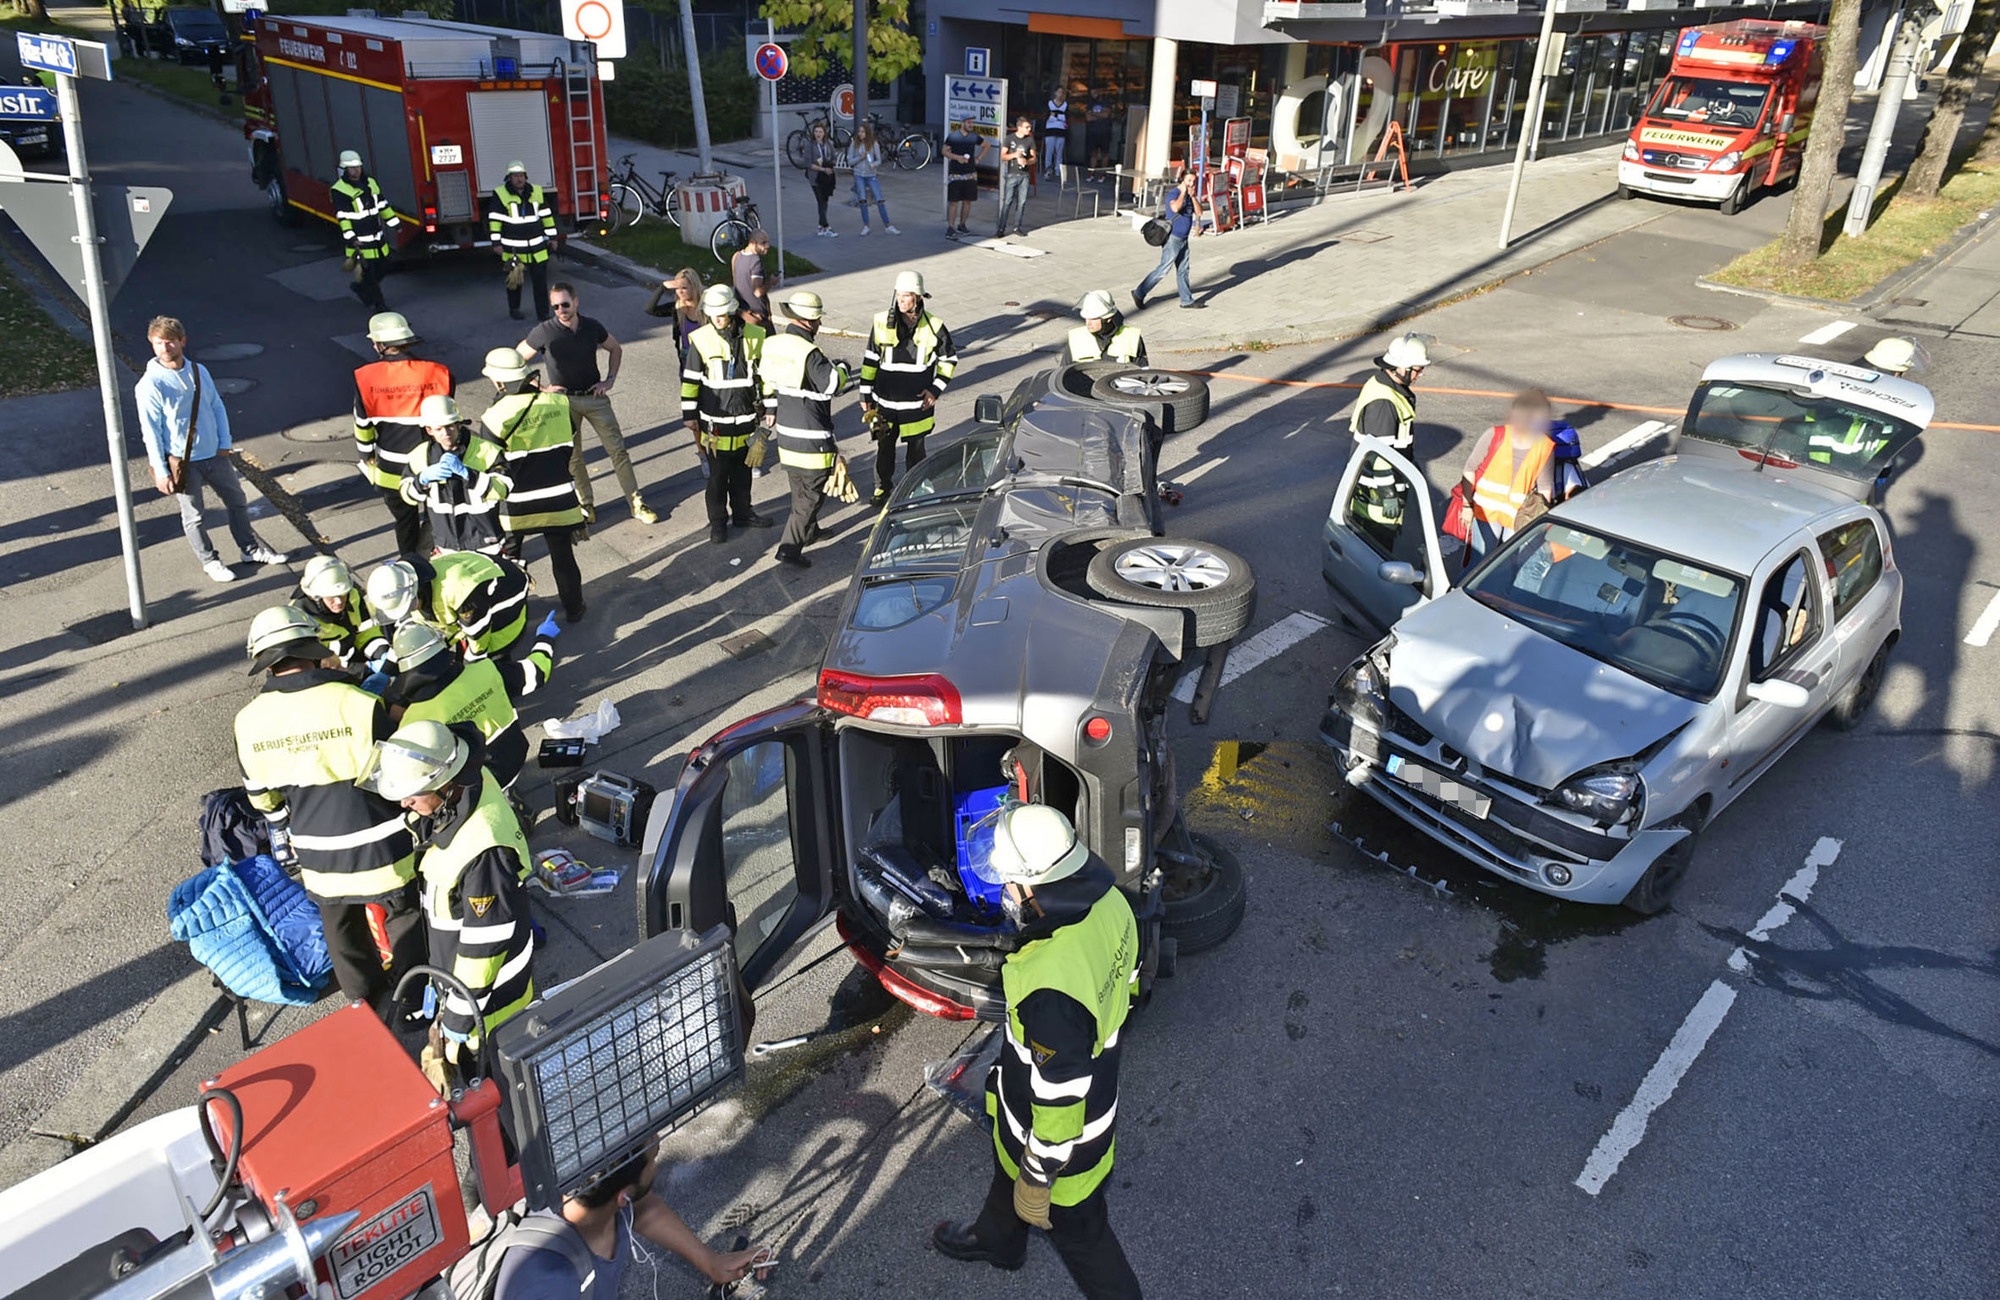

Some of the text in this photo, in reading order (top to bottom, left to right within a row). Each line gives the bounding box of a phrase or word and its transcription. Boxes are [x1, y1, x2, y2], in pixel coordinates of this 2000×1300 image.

[279, 38, 358, 70] FEUERWEHR 112
[0, 93, 46, 115] str.
[979, 105, 997, 121] pcs
[1644, 130, 1725, 147] FEUERWEHR
[336, 1197, 424, 1259] TEKLITE
[353, 1234, 422, 1287] ROBOT
[357, 1224, 413, 1271] LIGHT
